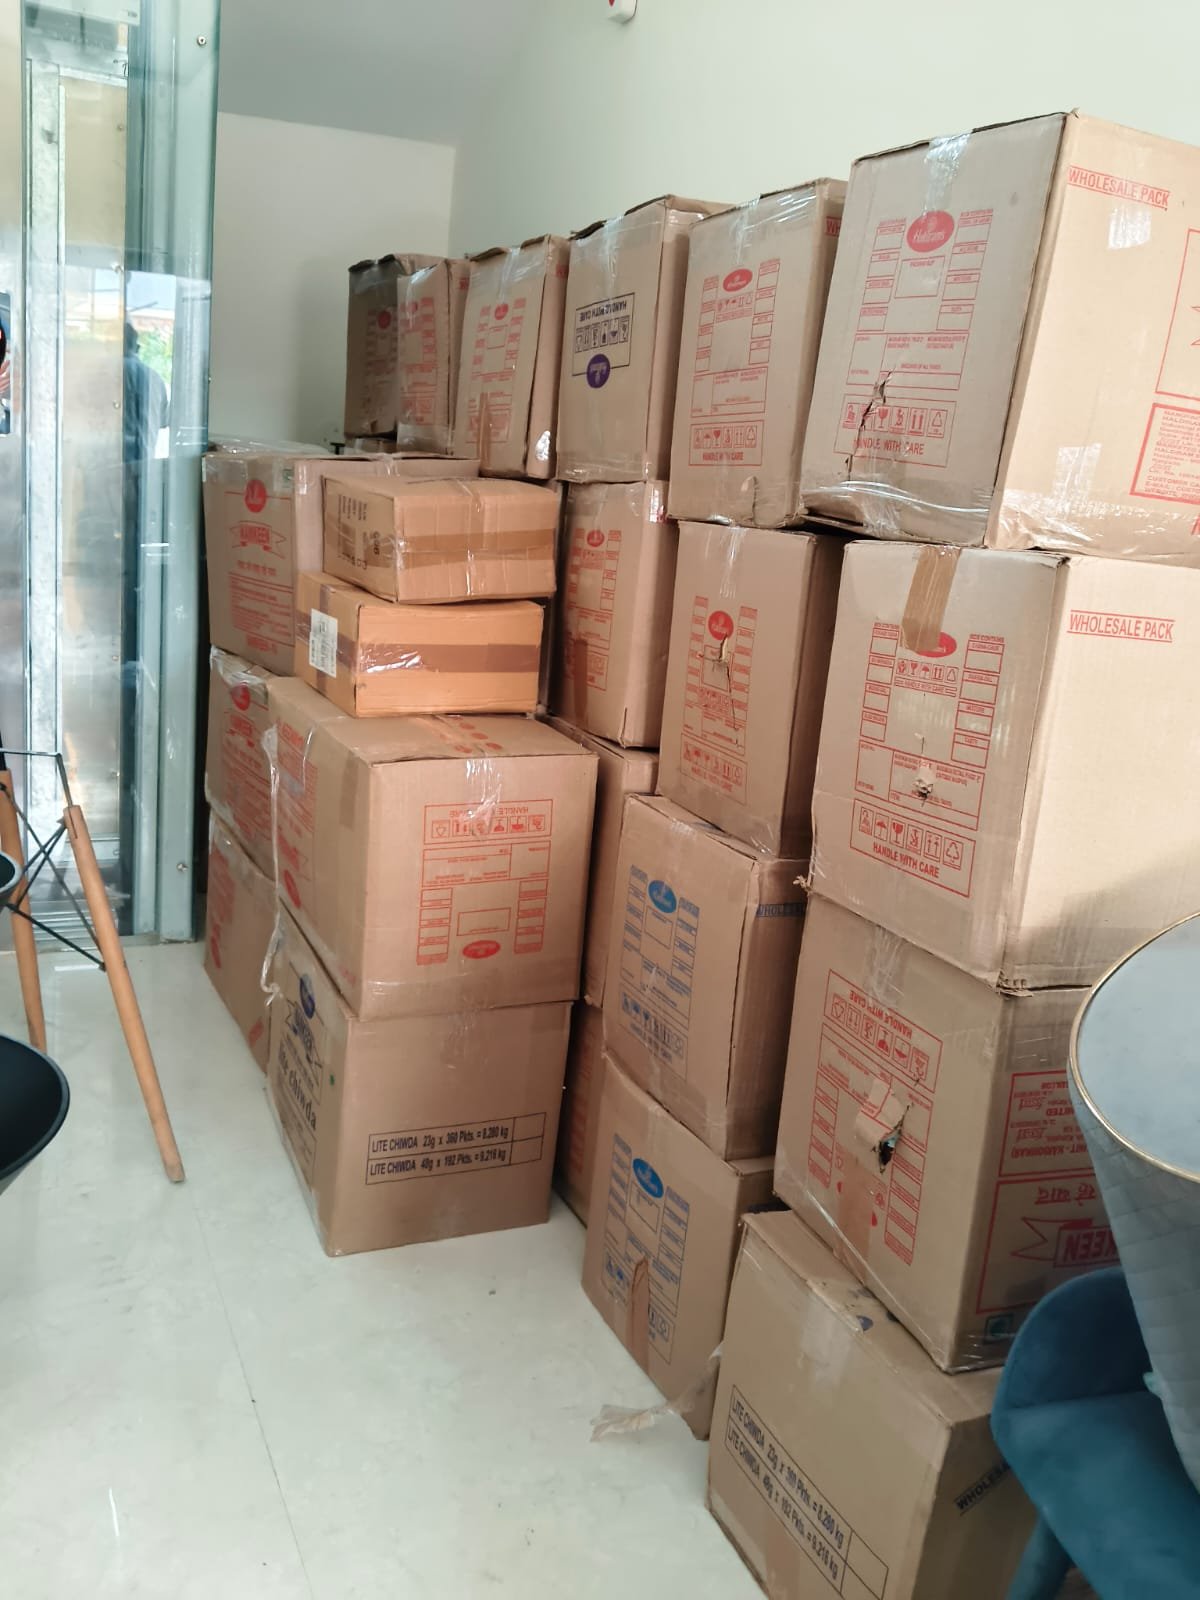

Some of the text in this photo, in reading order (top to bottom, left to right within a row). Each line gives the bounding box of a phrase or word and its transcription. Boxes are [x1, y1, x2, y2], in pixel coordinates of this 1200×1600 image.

[1068, 167, 1170, 206] WHOLESALE PACK
[883, 440, 901, 452] WITH
[1070, 613, 1174, 640] WHOLESALE PACK
[873, 842, 941, 878] HANDLE WITH CARE
[372, 1139, 388, 1153] LITE
[389, 1135, 418, 1151] CHIWDA
[438, 1136, 443, 1146] x
[500, 1125, 509, 1139] kg
[370, 1163, 386, 1176] LITE
[388, 1159, 416, 1174] CHIWDA
[498, 1148, 507, 1162] kg
[732, 1396, 744, 1422] LITE
[744, 1411, 765, 1450] CHIWDA
[835, 1523, 844, 1549] kg
[728, 1425, 739, 1450] LITE
[740, 1440, 760, 1480] CHIWDA
[830, 1555, 838, 1580] kg
